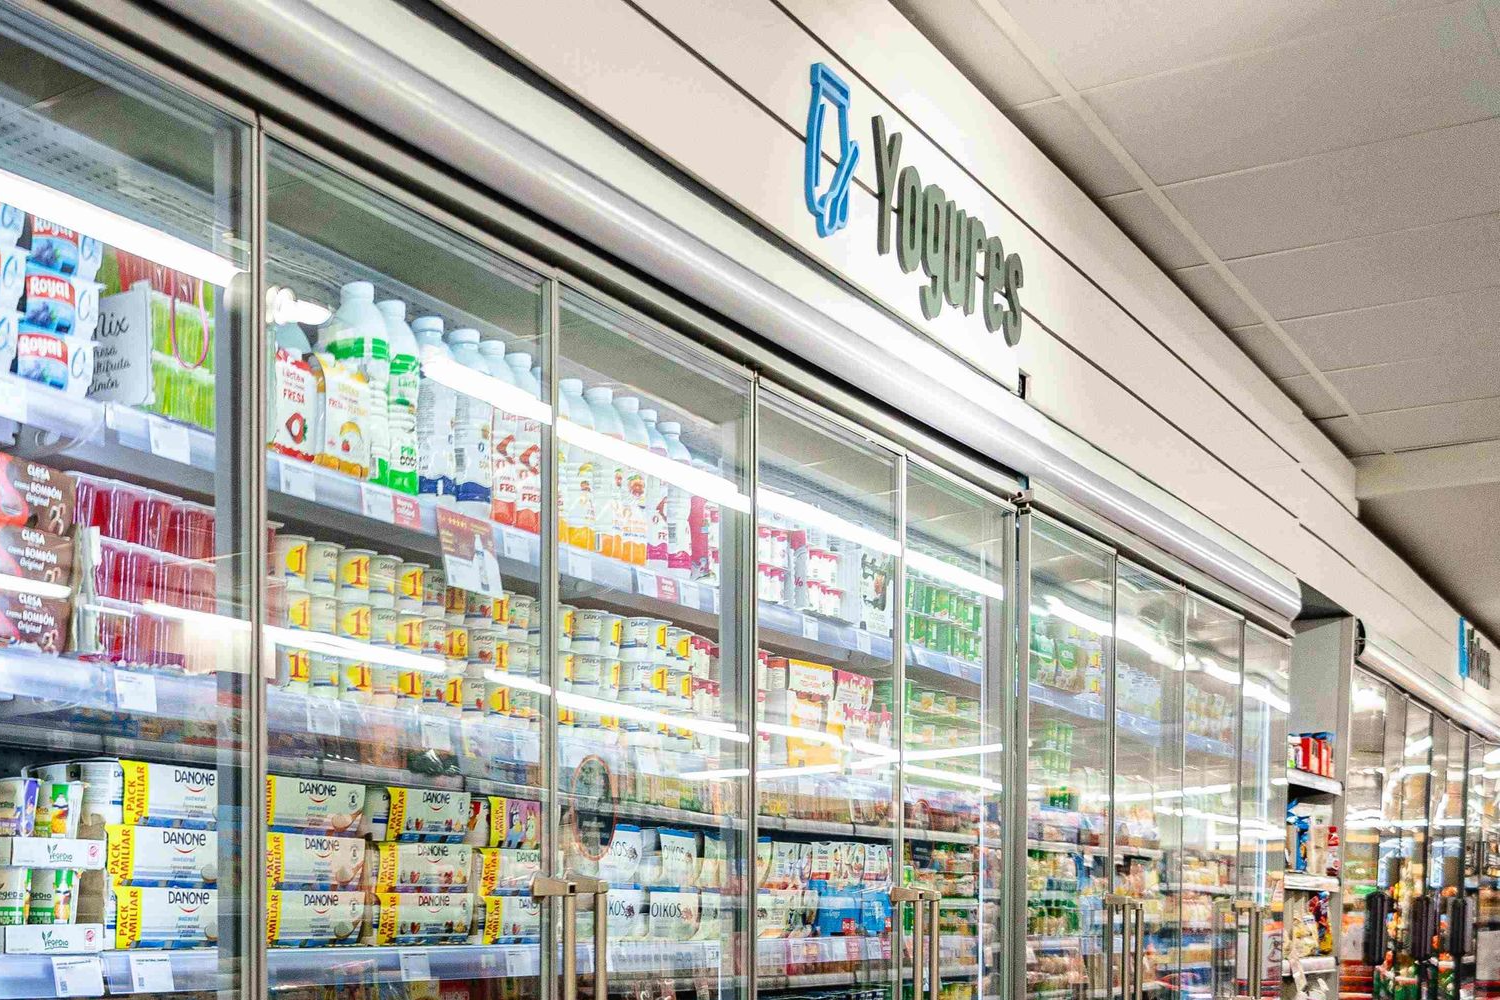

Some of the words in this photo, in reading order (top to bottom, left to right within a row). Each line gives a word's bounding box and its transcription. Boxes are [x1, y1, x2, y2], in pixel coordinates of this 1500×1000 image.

[871, 114, 1025, 348] Yogures
[29, 274, 71, 302] Royal
[18, 333, 64, 359] Royal
[126, 779, 137, 812] PACK
[389, 800, 397, 830] PACK
[109, 842, 121, 875] PACK
[118, 904, 129, 937] PACK
[380, 905, 388, 936] PACK
[651, 902, 682, 918] OIKOS
